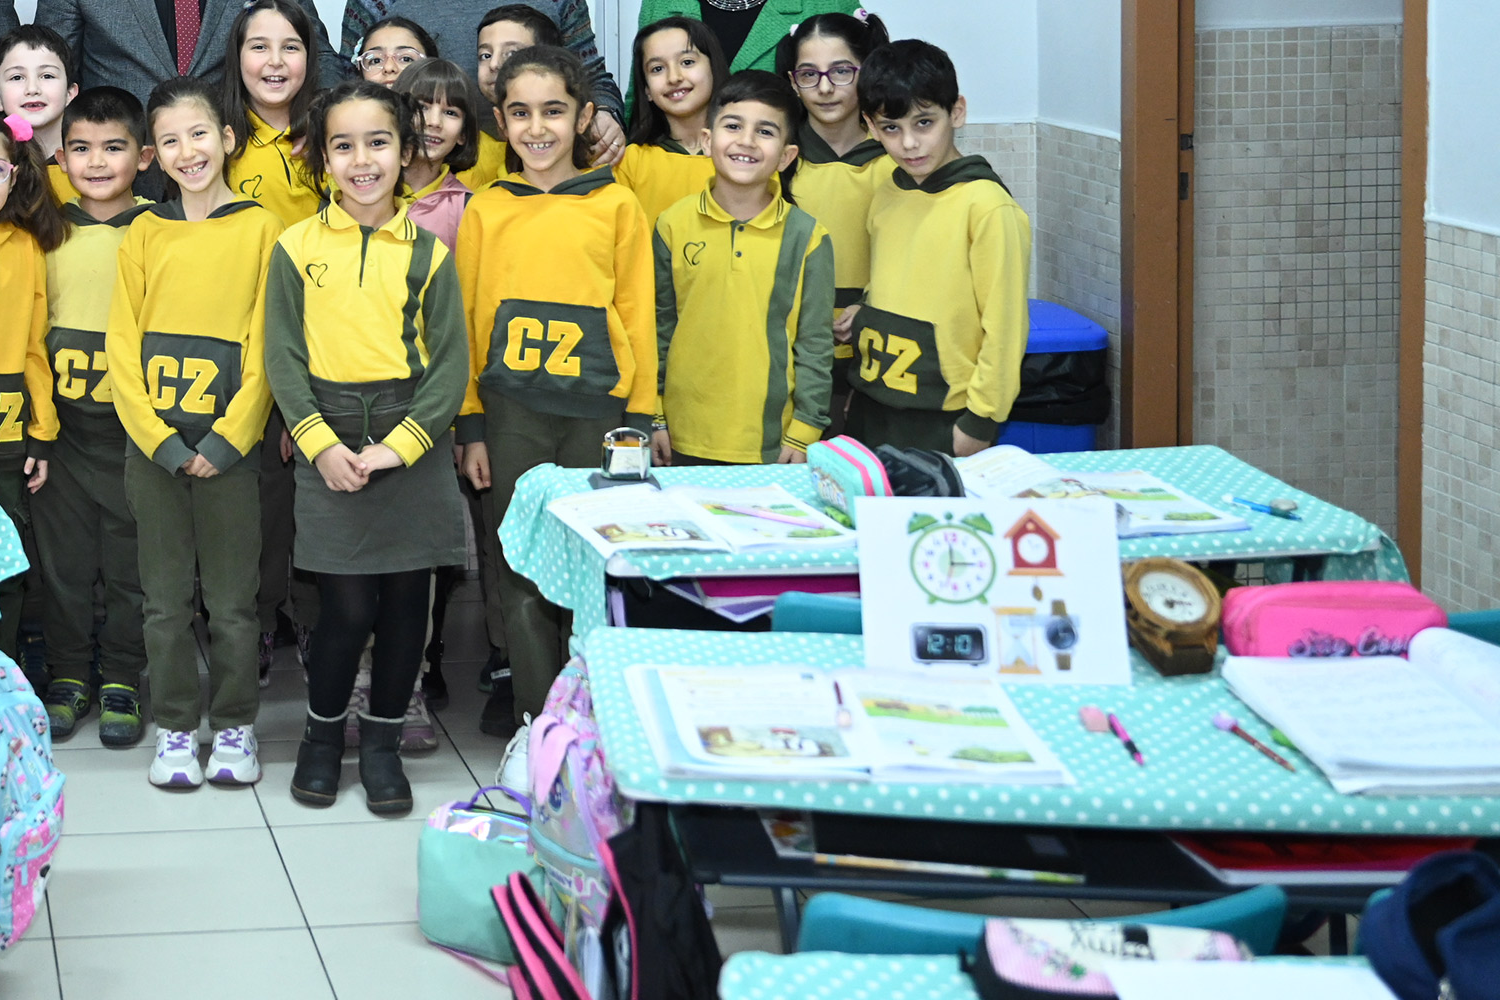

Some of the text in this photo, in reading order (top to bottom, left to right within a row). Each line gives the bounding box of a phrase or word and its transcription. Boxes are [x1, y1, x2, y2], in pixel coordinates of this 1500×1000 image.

[503, 316, 584, 378] CZ
[858, 326, 922, 395] CZ
[147, 355, 216, 415] CZ
[927, 633, 973, 656] 12:10
